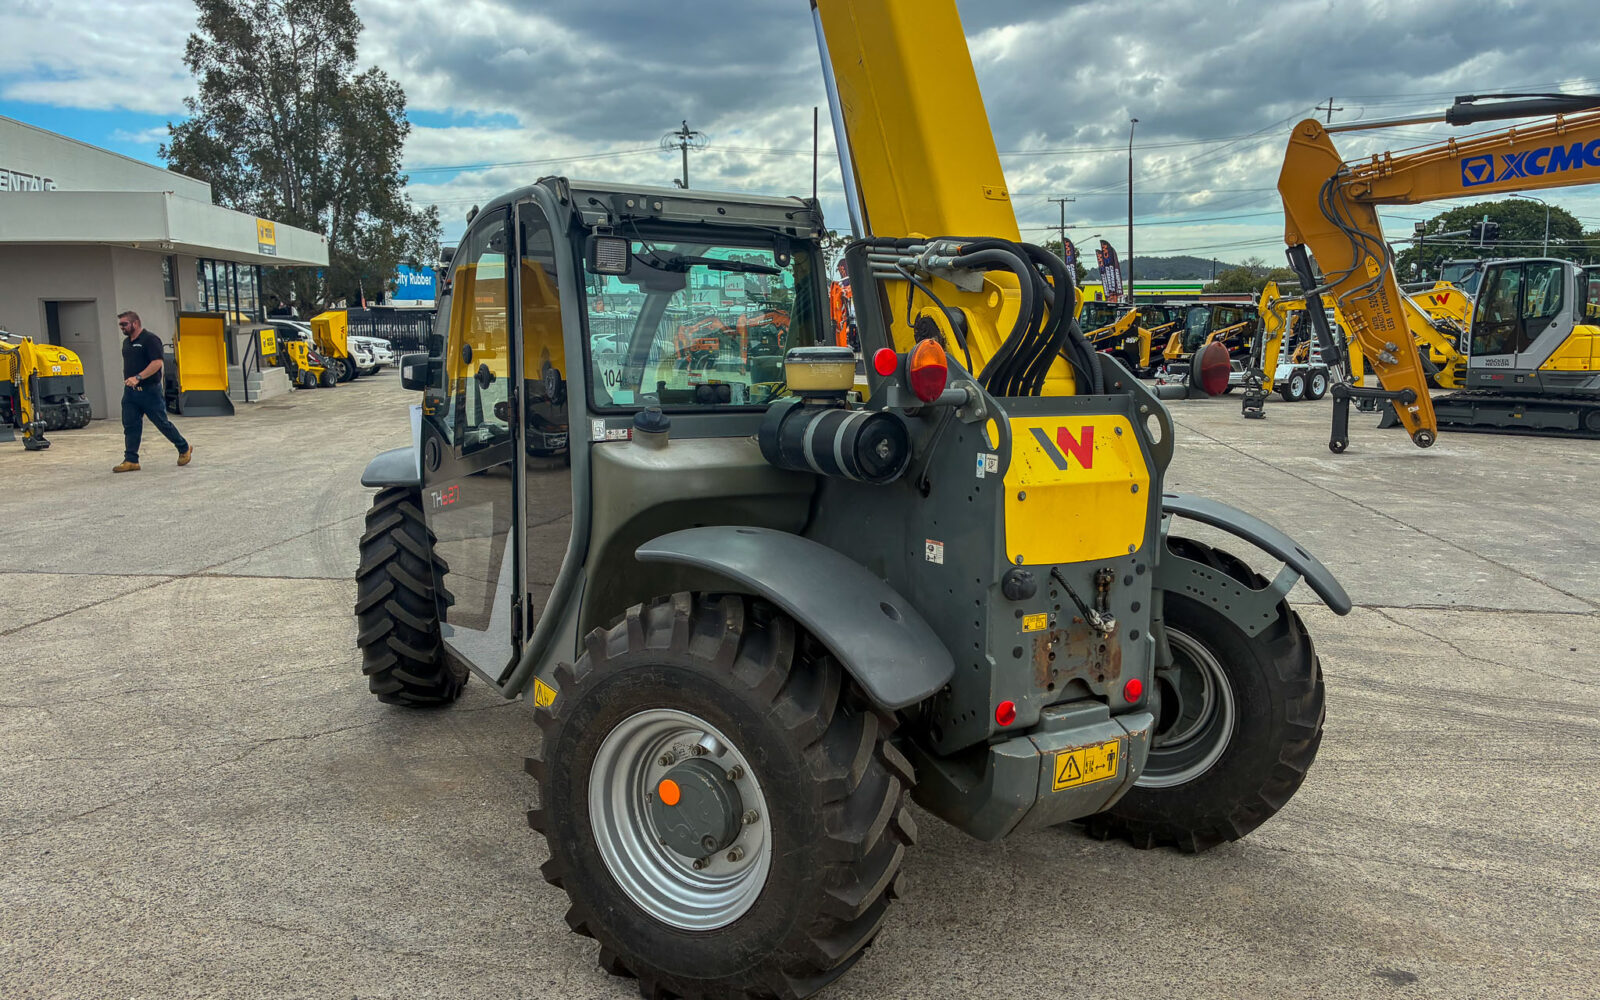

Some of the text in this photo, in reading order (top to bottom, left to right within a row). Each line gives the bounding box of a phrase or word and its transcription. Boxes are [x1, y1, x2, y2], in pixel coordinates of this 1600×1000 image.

[1496, 138, 1600, 182] XCMG
[409, 273, 431, 286] Rubber
[604, 369, 622, 387] 104
